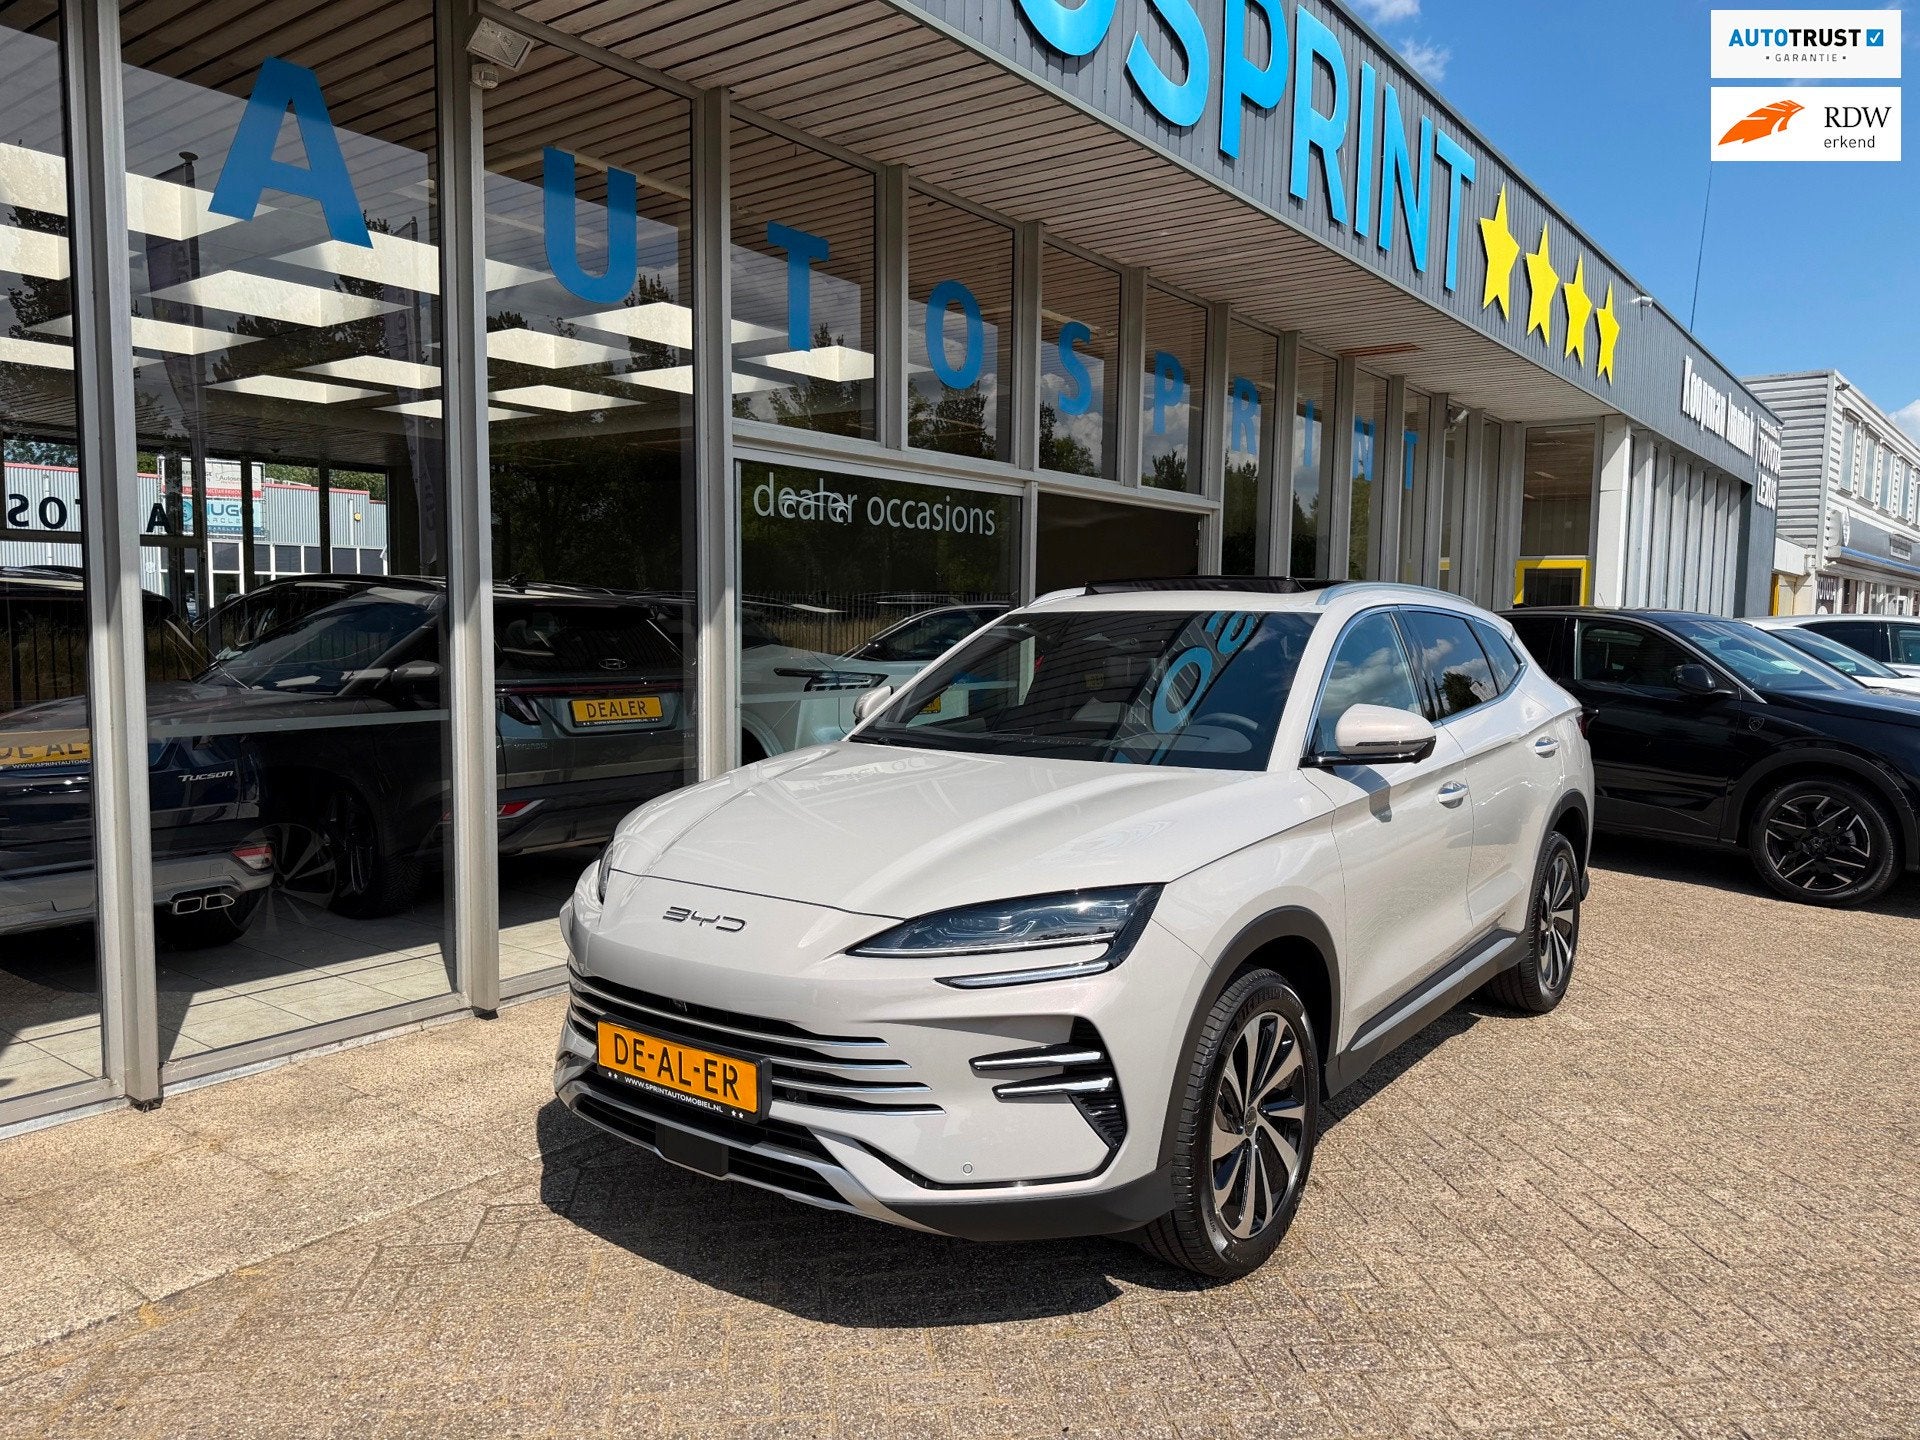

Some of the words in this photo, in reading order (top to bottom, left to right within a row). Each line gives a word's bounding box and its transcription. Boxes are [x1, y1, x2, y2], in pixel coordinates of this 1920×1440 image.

[753, 472, 858, 526] dealer
[867, 496, 996, 536] occasions
[1756, 471, 1778, 511] LEXUS
[586, 701, 648, 719] DEALER
[662, 906, 747, 933] BYD
[613, 1032, 740, 1101] DE-AL-ER
[623, 1076, 724, 1114] WWW.SPRINTAUTOMOBIEL.NL
